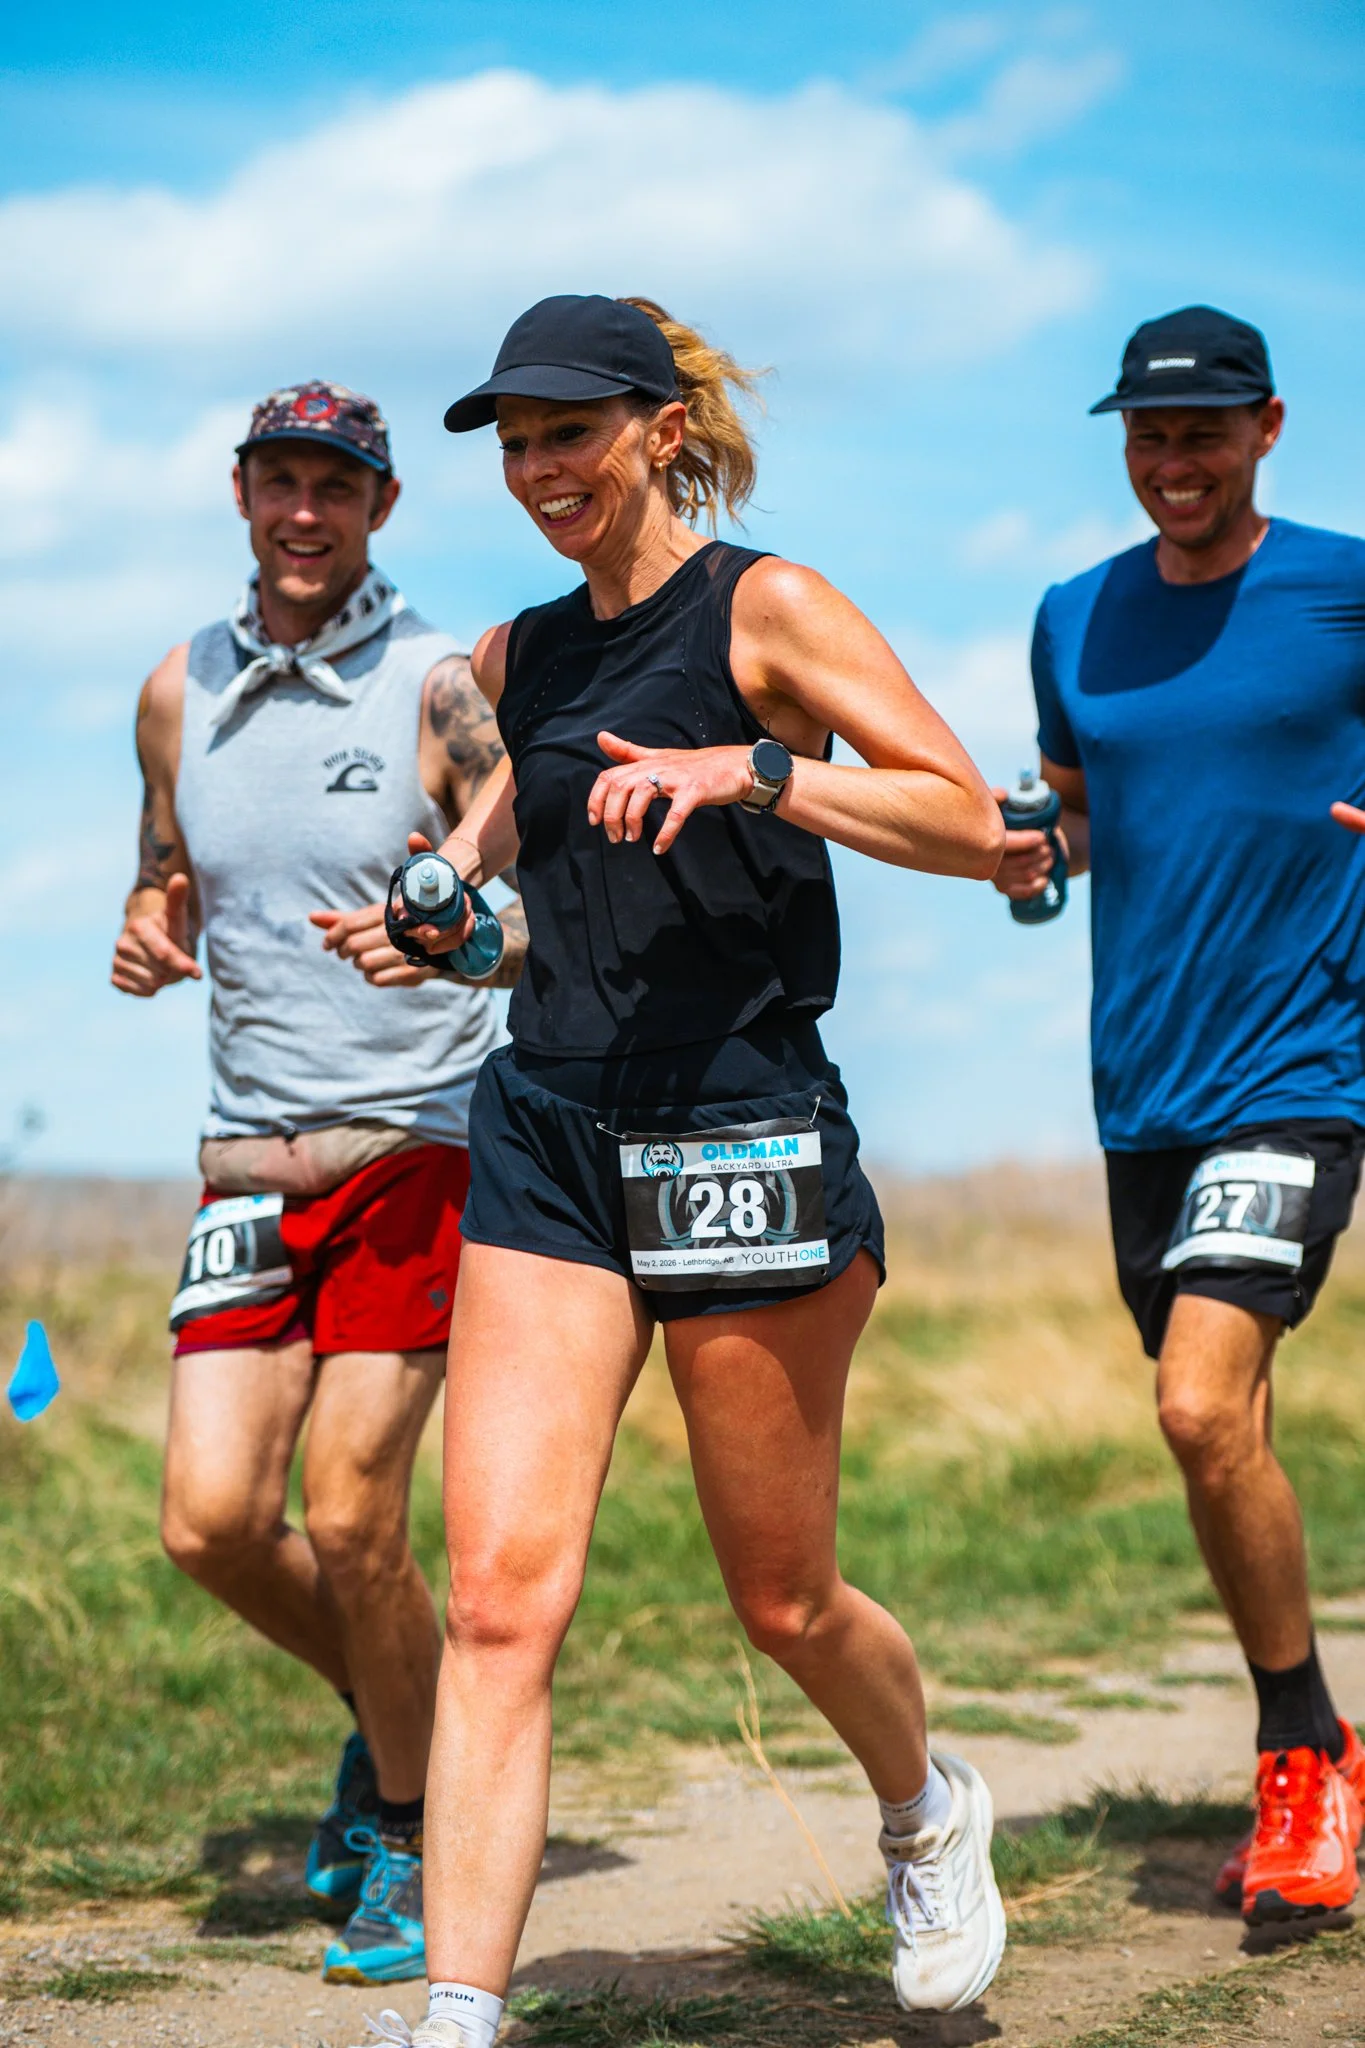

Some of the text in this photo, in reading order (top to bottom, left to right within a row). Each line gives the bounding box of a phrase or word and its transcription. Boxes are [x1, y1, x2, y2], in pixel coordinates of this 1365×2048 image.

[701, 1137, 799, 1161] OLDMAN
[711, 1160, 794, 1171] BACKYARD ULTRA
[688, 1180, 768, 1239] 28
[1192, 1183, 1257, 1232] 27
[189, 1227, 235, 1282] 10
[637, 1260, 650, 1268] May
[683, 1259, 722, 1267] Lethbridge,
[741, 1246, 826, 1265] YOUTHONE
